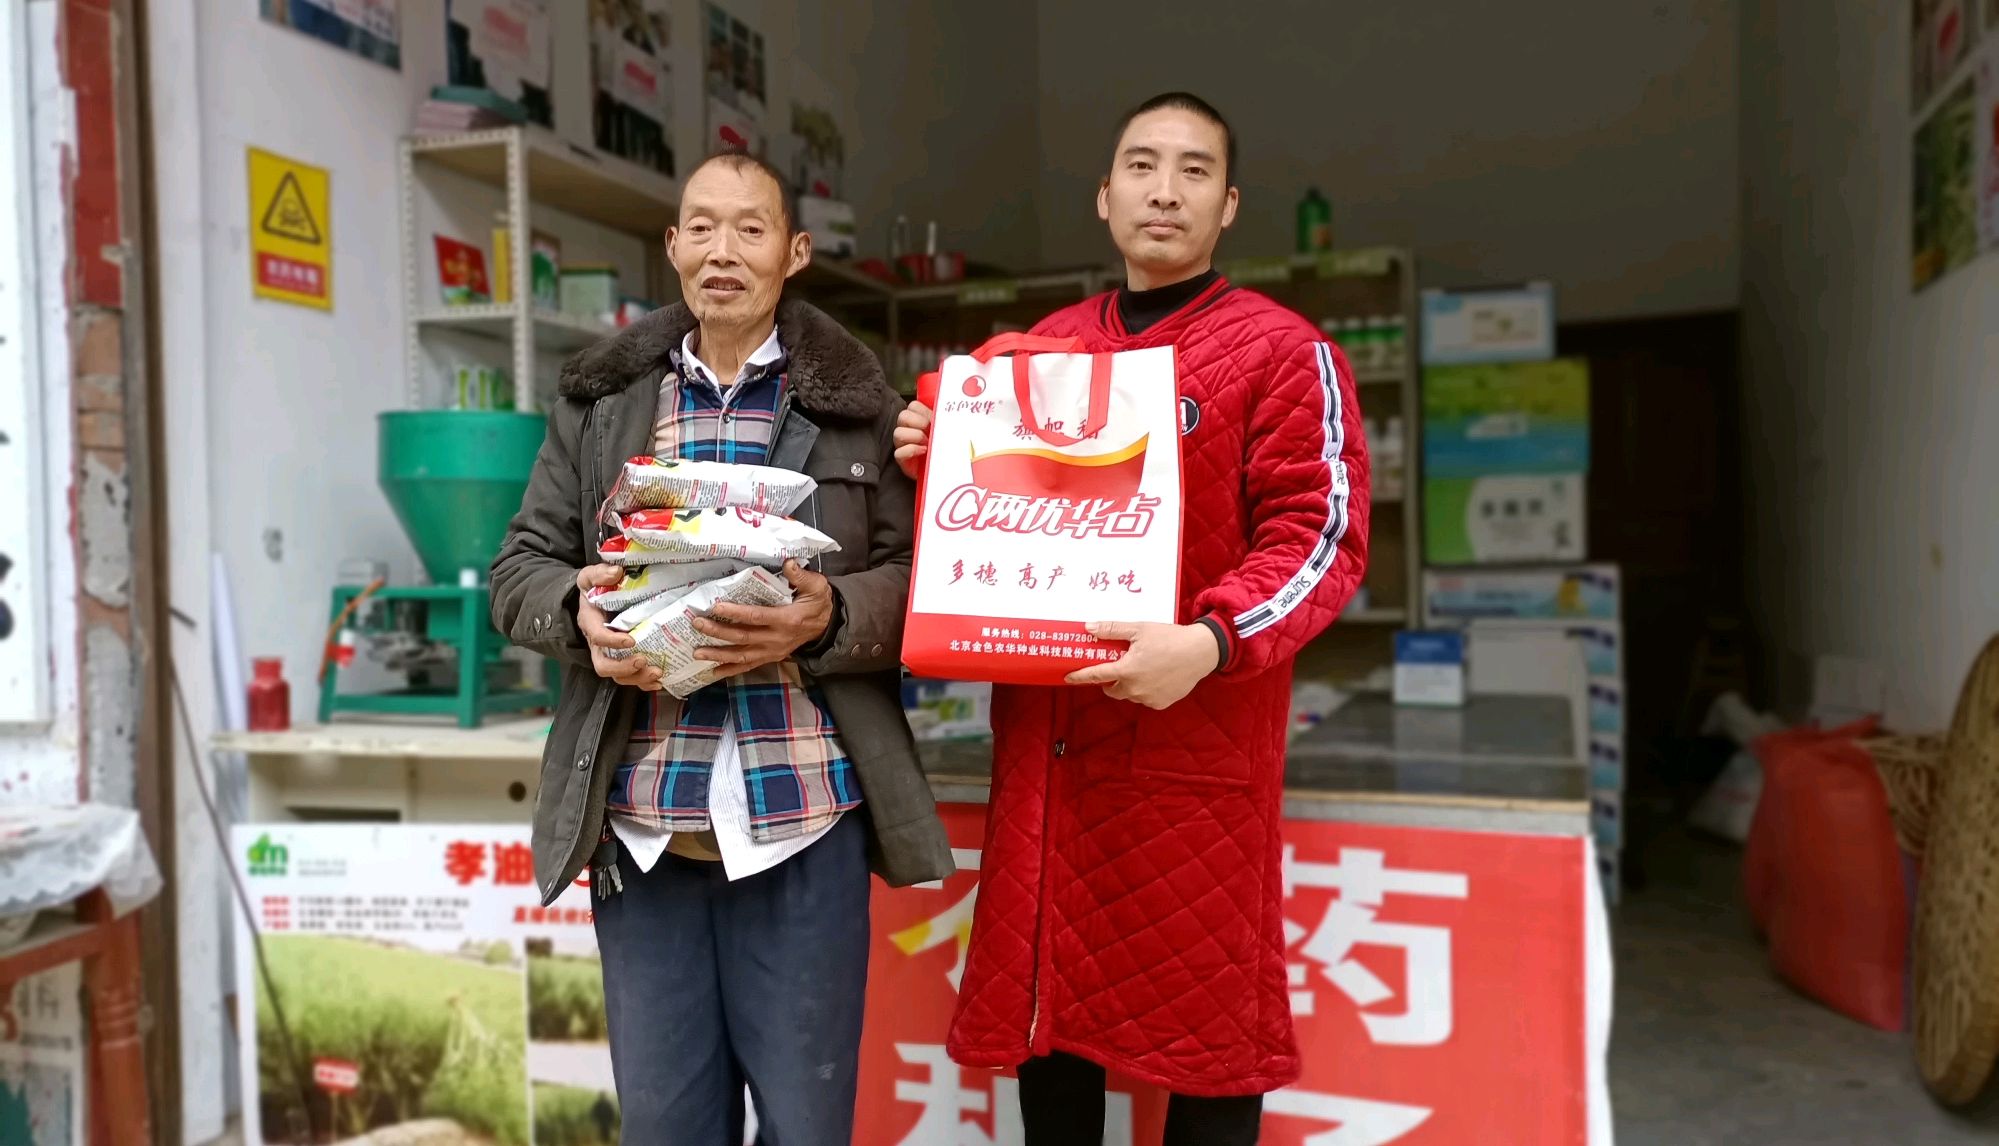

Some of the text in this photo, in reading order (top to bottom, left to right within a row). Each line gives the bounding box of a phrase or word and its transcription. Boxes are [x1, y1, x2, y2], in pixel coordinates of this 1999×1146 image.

[948, 559, 1142, 593] 多穗 高产 好吃
